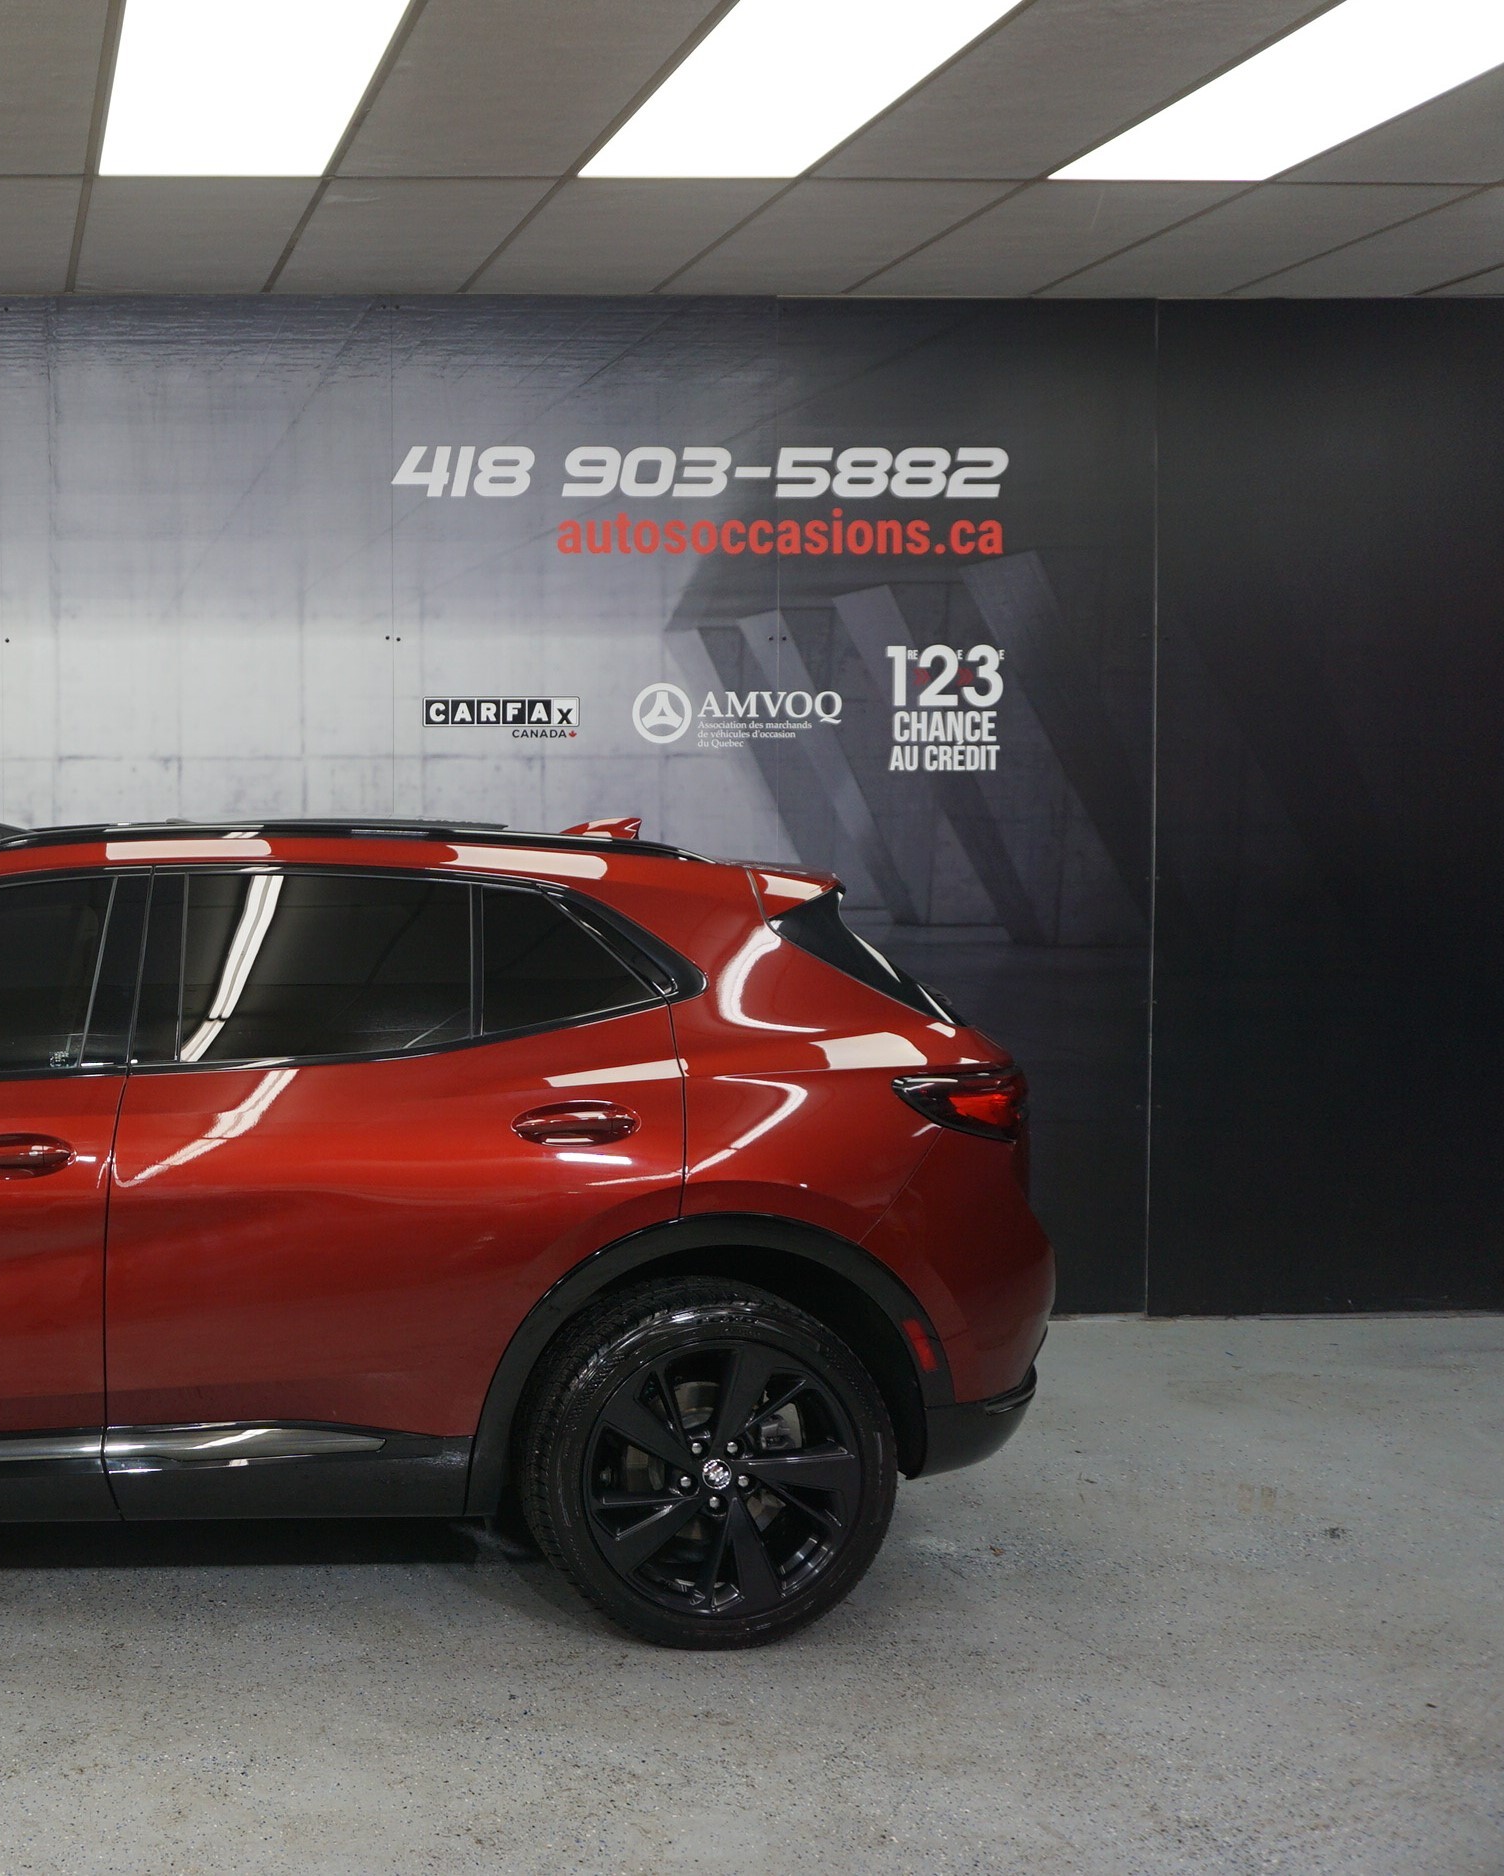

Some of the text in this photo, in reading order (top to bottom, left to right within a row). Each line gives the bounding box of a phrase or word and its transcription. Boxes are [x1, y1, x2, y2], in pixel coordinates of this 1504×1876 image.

[391, 446, 1010, 498] 418 903-5882
[556, 508, 1004, 556] autosoccasions.ca
[697, 691, 843, 724] AMVOQ
[512, 729, 567, 739] CANADA
[697, 720, 813, 730] Association des marchands
[697, 729, 797, 739] de véhicules d'occasion
[893, 710, 998, 742] CHANCE
[697, 739, 709, 748] du
[889, 740, 1001, 771] AU CRÉDIT
